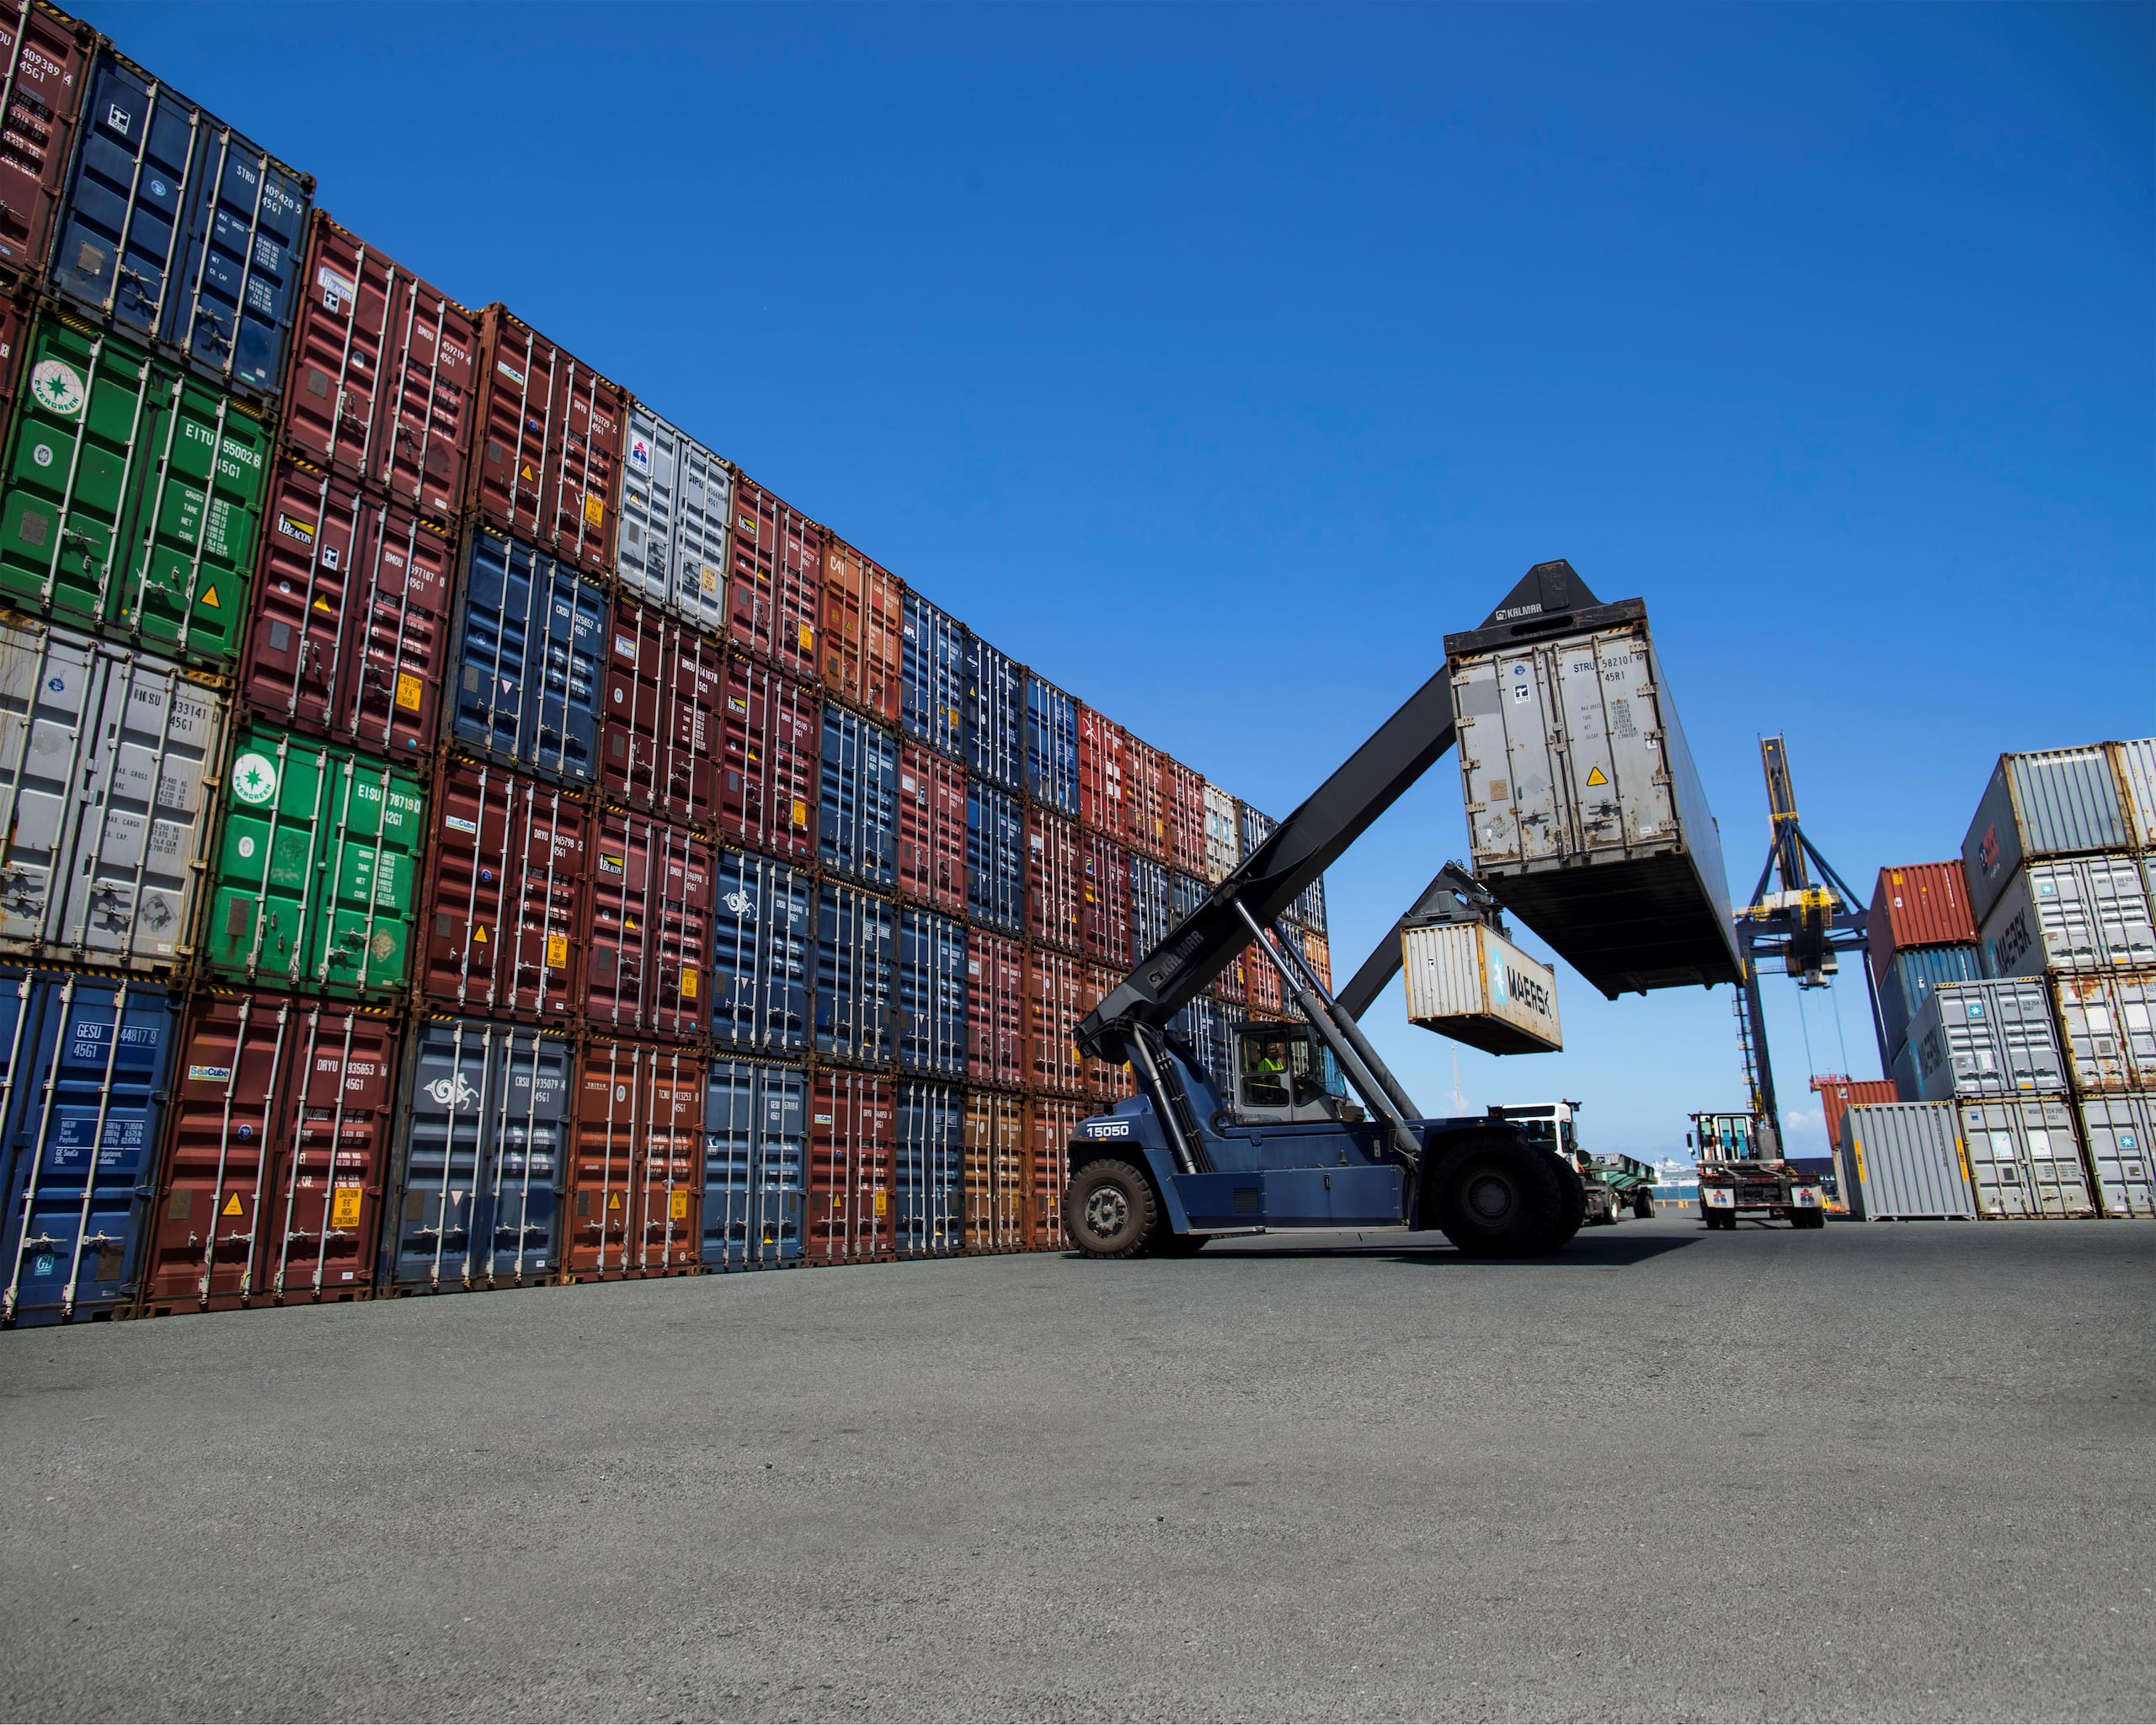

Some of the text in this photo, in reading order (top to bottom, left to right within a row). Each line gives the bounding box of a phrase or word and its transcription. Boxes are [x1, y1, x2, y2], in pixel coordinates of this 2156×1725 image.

[19, 61, 45, 83] 45G1
[22, 47, 61, 77] 409389
[64, 72, 72, 86] 4
[237, 165, 302, 215] STRU 409420 5
[262, 196, 282, 216] 45G1
[417, 324, 472, 366] BMOU 459219 4
[440, 351, 456, 367] 45G1
[34, 378, 79, 411] EVERGREEN
[574, 399, 617, 434] DRYU 963729 2
[591, 421, 604, 435] 45G1
[185, 423, 262, 469] EITU 55002 6
[184, 489, 204, 503] GROSS
[184, 503, 198, 515] TARE
[180, 516, 193, 527] NET
[179, 530, 194, 542] CUBE
[282, 521, 312, 545] BEACON
[385, 551, 446, 587] BMOU 597187 0
[830, 555, 845, 576] CAI
[409, 577, 424, 591] 45G1
[556, 604, 569, 617] CRSU
[574, 612, 594, 630] 925652
[1508, 603, 1542, 618] KALMAR
[574, 624, 587, 638] 45G1
[904, 624, 916, 639] APL
[681, 658, 696, 672] BMOU
[1573, 661, 1595, 673] STRU
[1602, 654, 1632, 669] 582101
[398, 674, 422, 690] CAUTION
[1604, 670, 1625, 682] 45R1
[696, 681, 708, 694] 5G1
[171, 701, 207, 720] 433141
[169, 715, 193, 732] 45G1
[131, 770, 148, 781] GROSS
[235, 775, 271, 799] EVERGREEN
[358, 783, 382, 802] EISU
[387, 792, 414, 811] 78719
[122, 818, 141, 829] CARGO
[446, 815, 476, 830] SeaCube
[116, 831, 128, 841] CAP.
[534, 828, 584, 852] DRYU 965798 2
[358, 849, 374, 860] GROSS
[357, 862, 370, 873] TARE
[602, 859, 622, 875] BEACON
[355, 876, 366, 885] NET
[670, 866, 681, 878] BMOU
[686, 870, 702, 884] 596998
[354, 890, 367, 899] CUBE
[1161, 929, 1205, 975] KALMAR
[1507, 965, 1552, 1019] MAERSK
[77, 1023, 157, 1044] GESU 44817 9
[73, 1044, 98, 1058] 45G1
[189, 1065, 229, 1079] SeaCube
[317, 1059, 338, 1072] DRYU
[347, 1061, 375, 1076] 935653
[345, 1077, 364, 1091] 45G1
[515, 1076, 566, 1092] CRSU 935079 4
[535, 1092, 550, 1103] 45G1
[659, 1089, 670, 1100] TCNU
[675, 1092, 691, 1102] 413253
[61, 1120, 77, 1129] MGW
[58, 1135, 79, 1145] Payload
[339, 1188, 358, 1198] CAUTION
[340, 1208, 352, 1216] HIGH
[334, 1216, 358, 1226] CONTAINER
